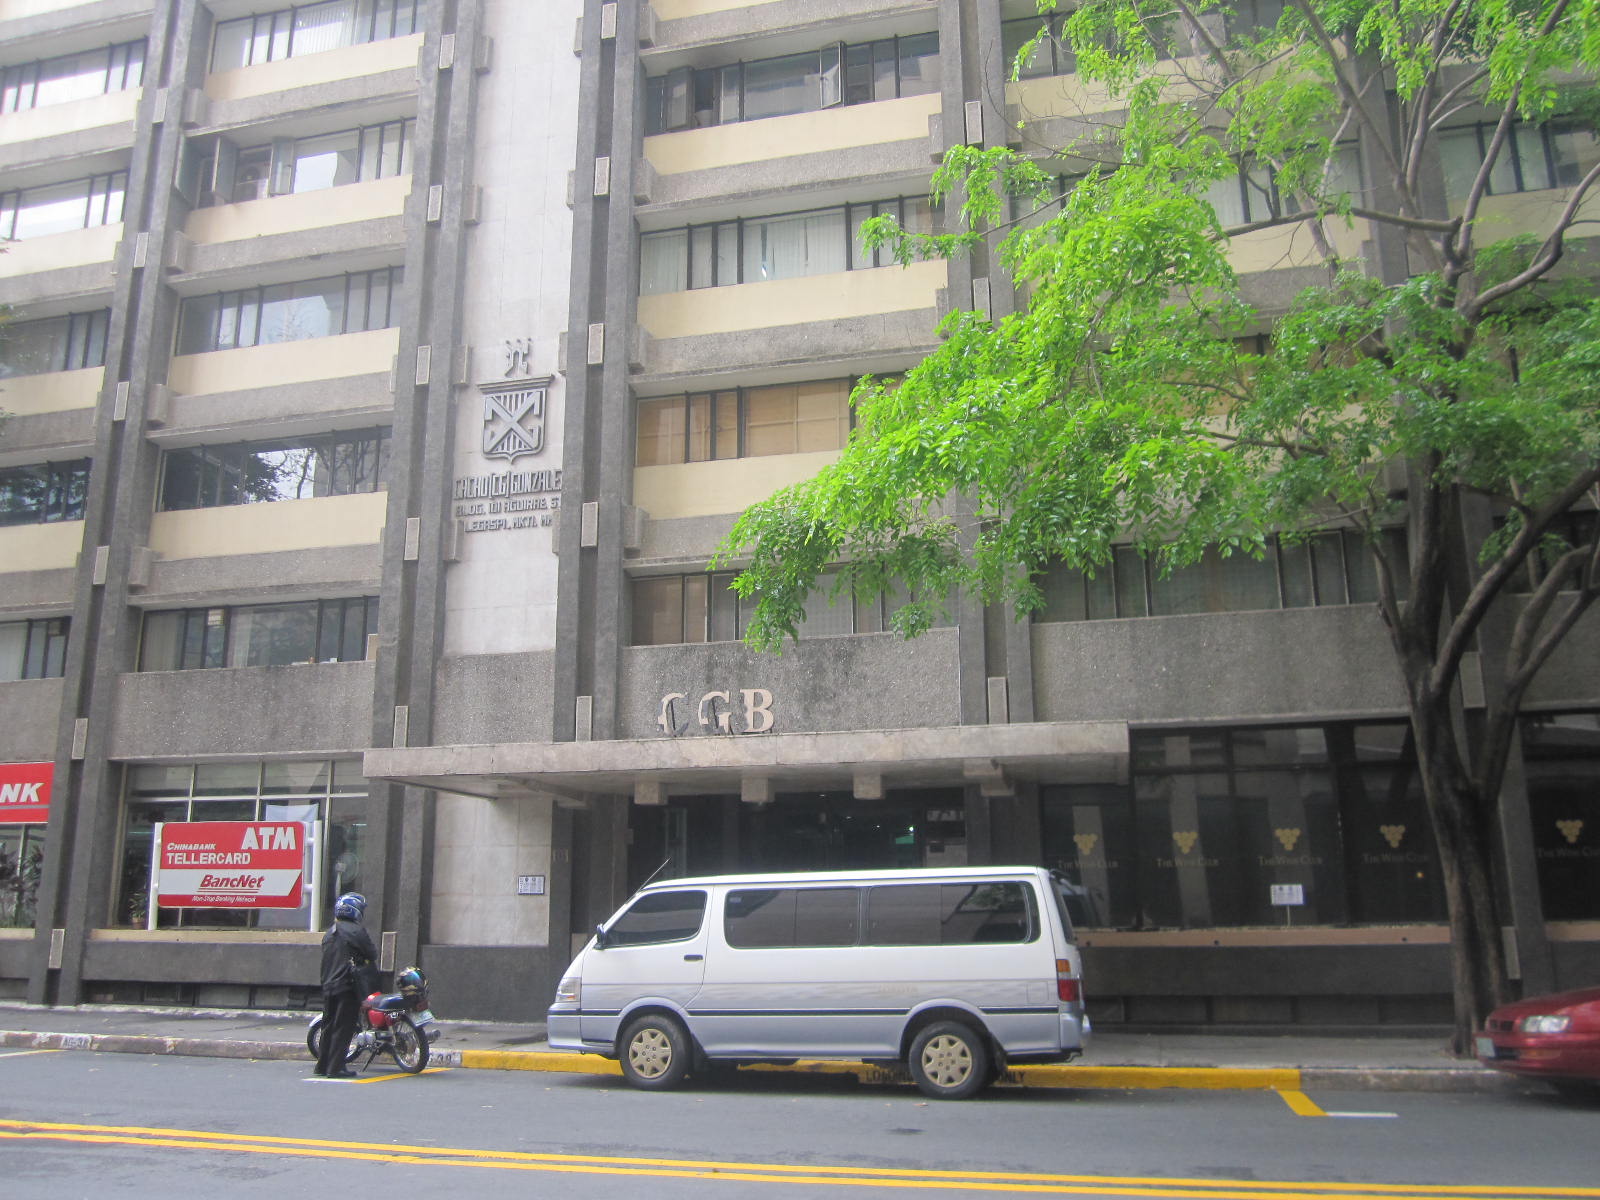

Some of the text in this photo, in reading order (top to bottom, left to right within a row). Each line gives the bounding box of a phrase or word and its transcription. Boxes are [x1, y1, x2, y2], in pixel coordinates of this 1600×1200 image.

[240, 826, 297, 851] ATM
[166, 852, 251, 865] TELLERCARD
[200, 874, 266, 889] BancNet
